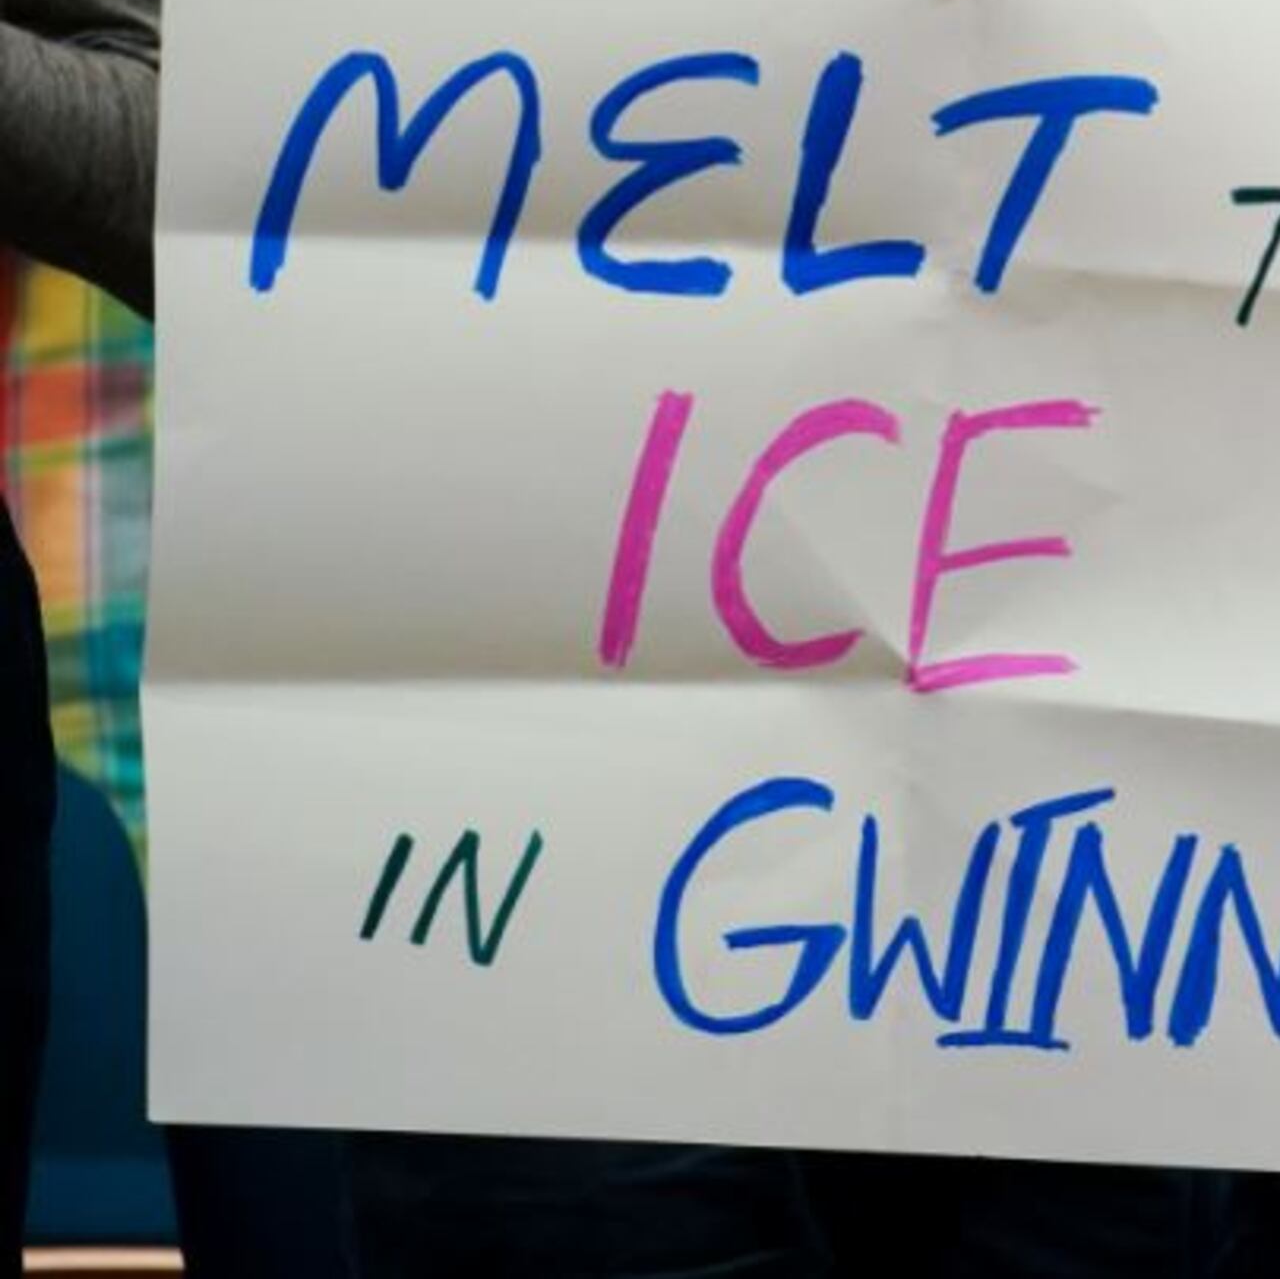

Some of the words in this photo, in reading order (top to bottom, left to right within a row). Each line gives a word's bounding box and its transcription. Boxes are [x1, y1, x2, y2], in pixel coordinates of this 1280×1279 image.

[248, 49, 1162, 301] MELT
[596, 389, 1104, 695] ICE
[358, 827, 544, 969] IN
